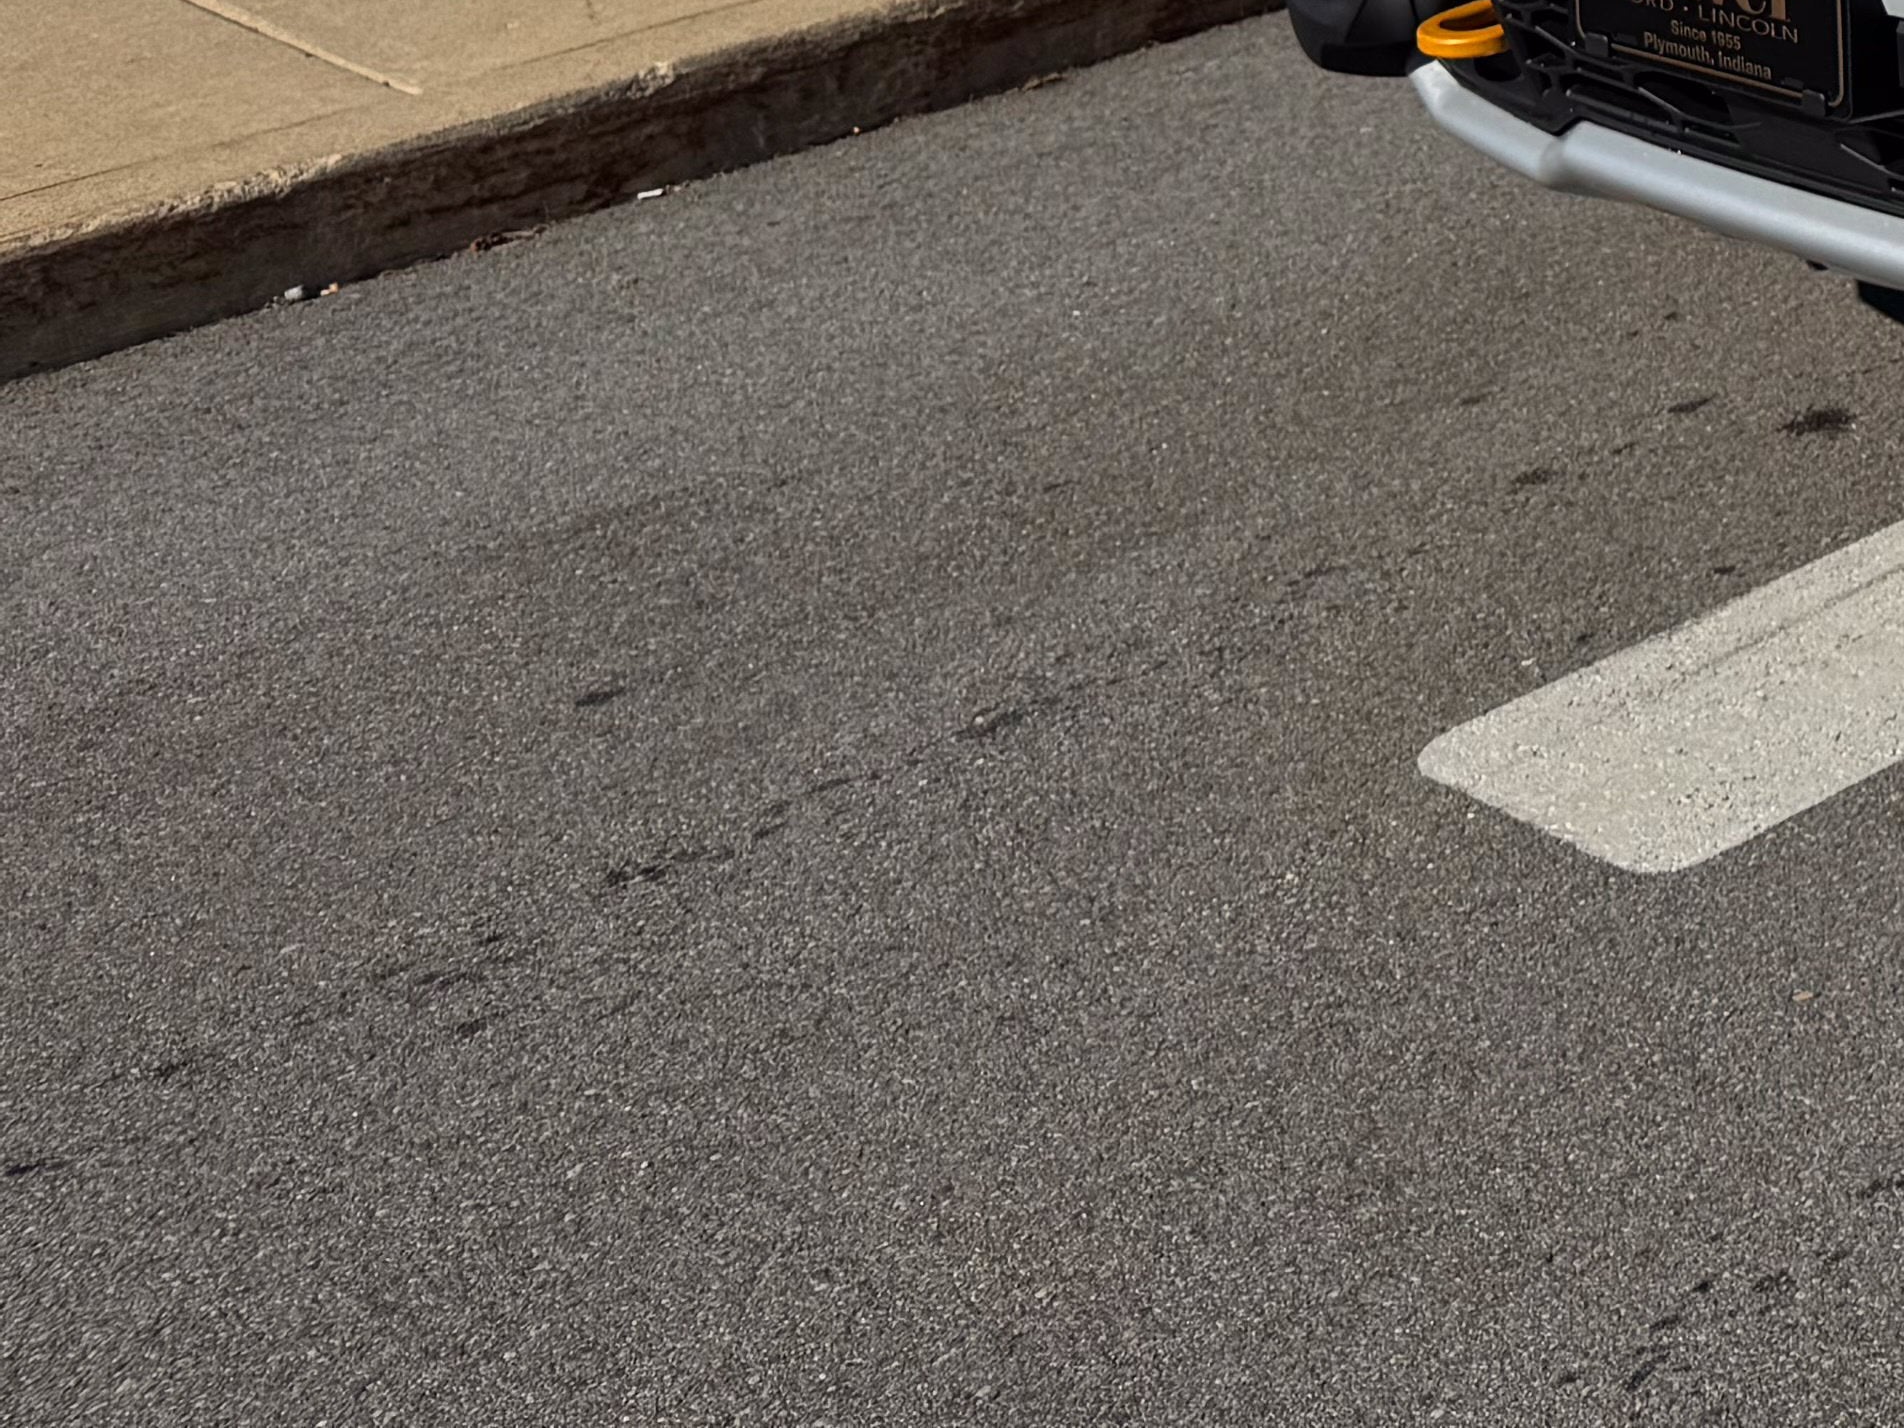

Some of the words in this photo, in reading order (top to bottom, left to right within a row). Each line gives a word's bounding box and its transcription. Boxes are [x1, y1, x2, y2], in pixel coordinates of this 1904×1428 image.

[1670, 19, 1707, 42] Since
[1698, 4, 1799, 44] LINCOLN
[1718, 50, 1772, 81] Indiana
